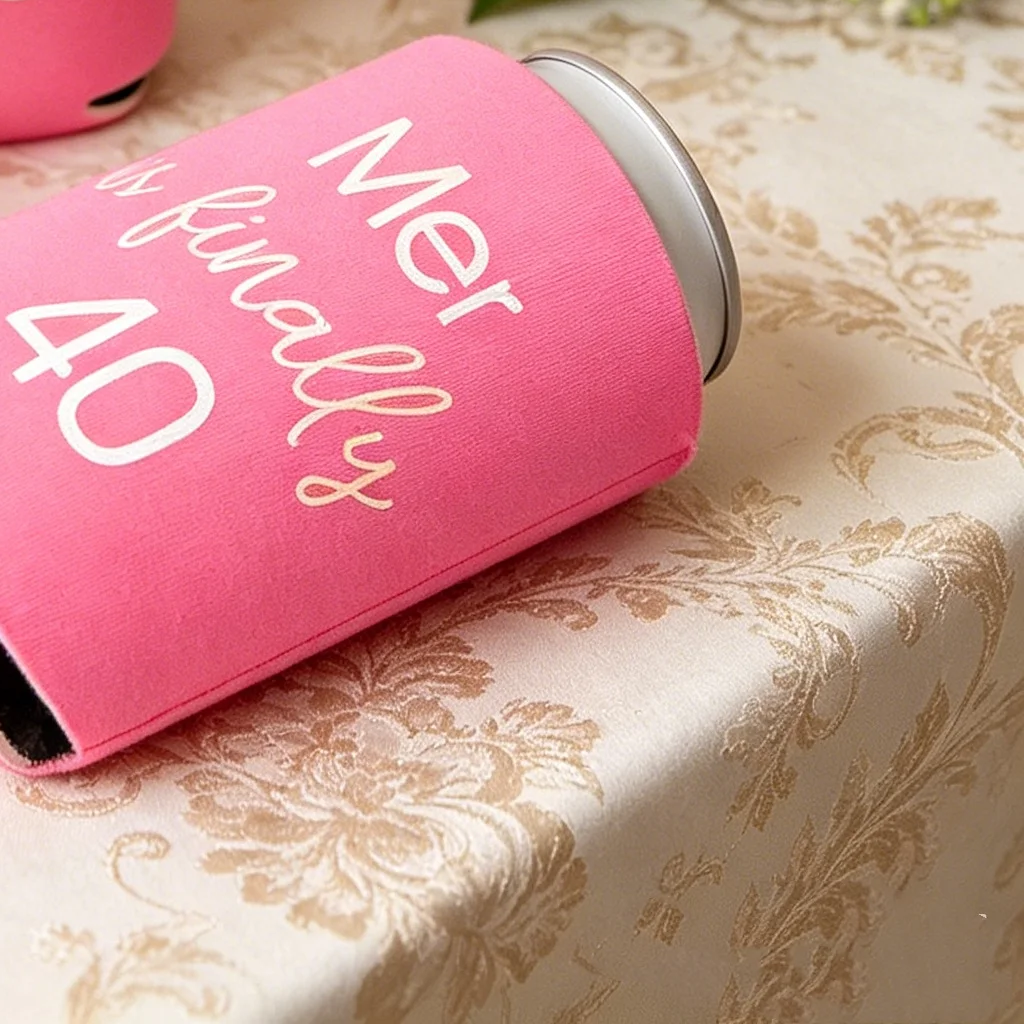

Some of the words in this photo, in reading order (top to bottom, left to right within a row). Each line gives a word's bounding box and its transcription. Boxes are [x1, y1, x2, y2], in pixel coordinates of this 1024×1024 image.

[93, 157, 178, 197] is
[306, 116, 524, 327] Mer
[4, 297, 216, 467] 40
[116, 184, 453, 511] finally
